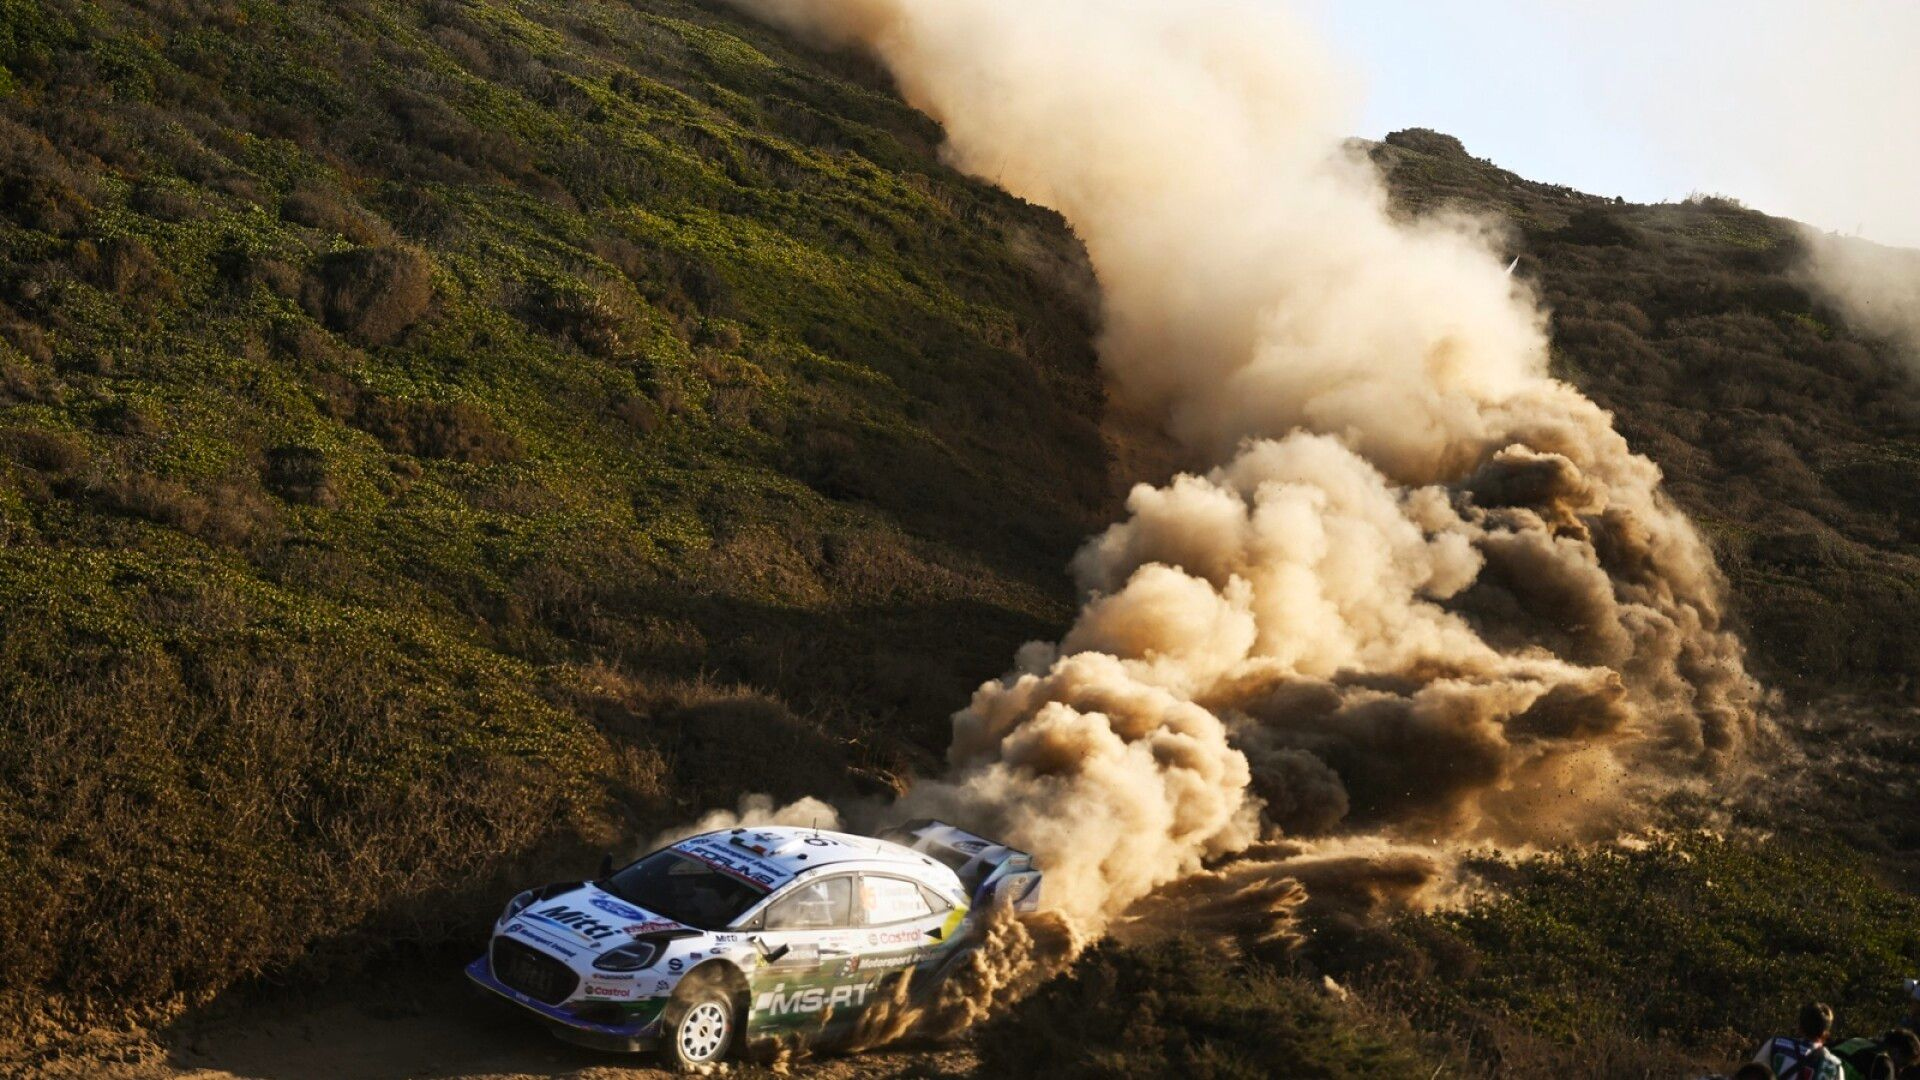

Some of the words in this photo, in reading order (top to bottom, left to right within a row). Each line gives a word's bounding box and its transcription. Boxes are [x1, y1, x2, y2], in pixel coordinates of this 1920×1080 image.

[537, 905, 623, 940] Mitti
[879, 928, 922, 944] Castrol
[593, 987, 631, 997] Castrol
[769, 983, 870, 1016] MS-RT
